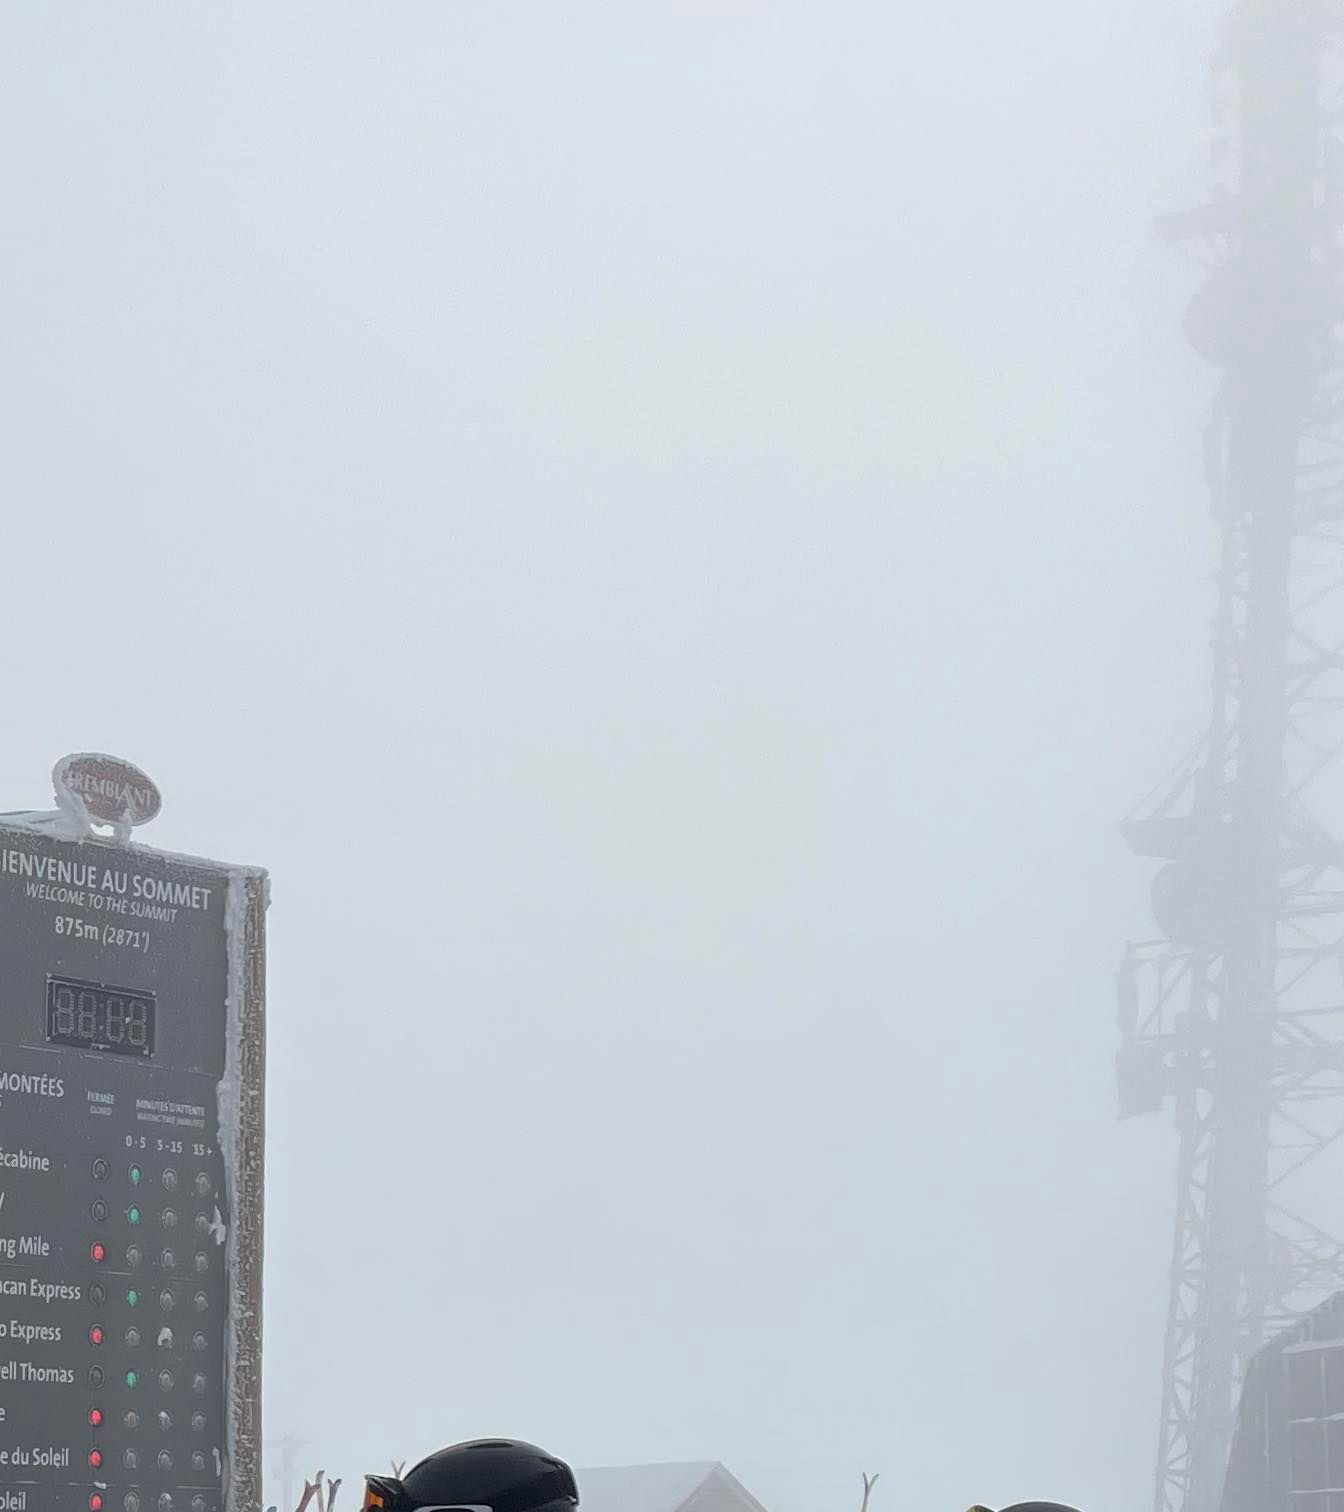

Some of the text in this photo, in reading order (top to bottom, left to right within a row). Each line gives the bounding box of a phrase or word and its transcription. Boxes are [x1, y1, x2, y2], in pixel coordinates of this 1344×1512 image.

[100, 869, 128, 894] AU
[132, 875, 212, 911] SOMMET
[24, 881, 178, 924] WELCOME TO THE SUMMIT
[54, 915, 99, 941] 875m
[18, 1236, 50, 1257] Mile
[29, 1278, 82, 1303] Express
[10, 1320, 62, 1344] Express
[19, 1362, 75, 1384] Thomas
[11, 1446, 30, 1466] du
[32, 1447, 69, 1468] Soleil
